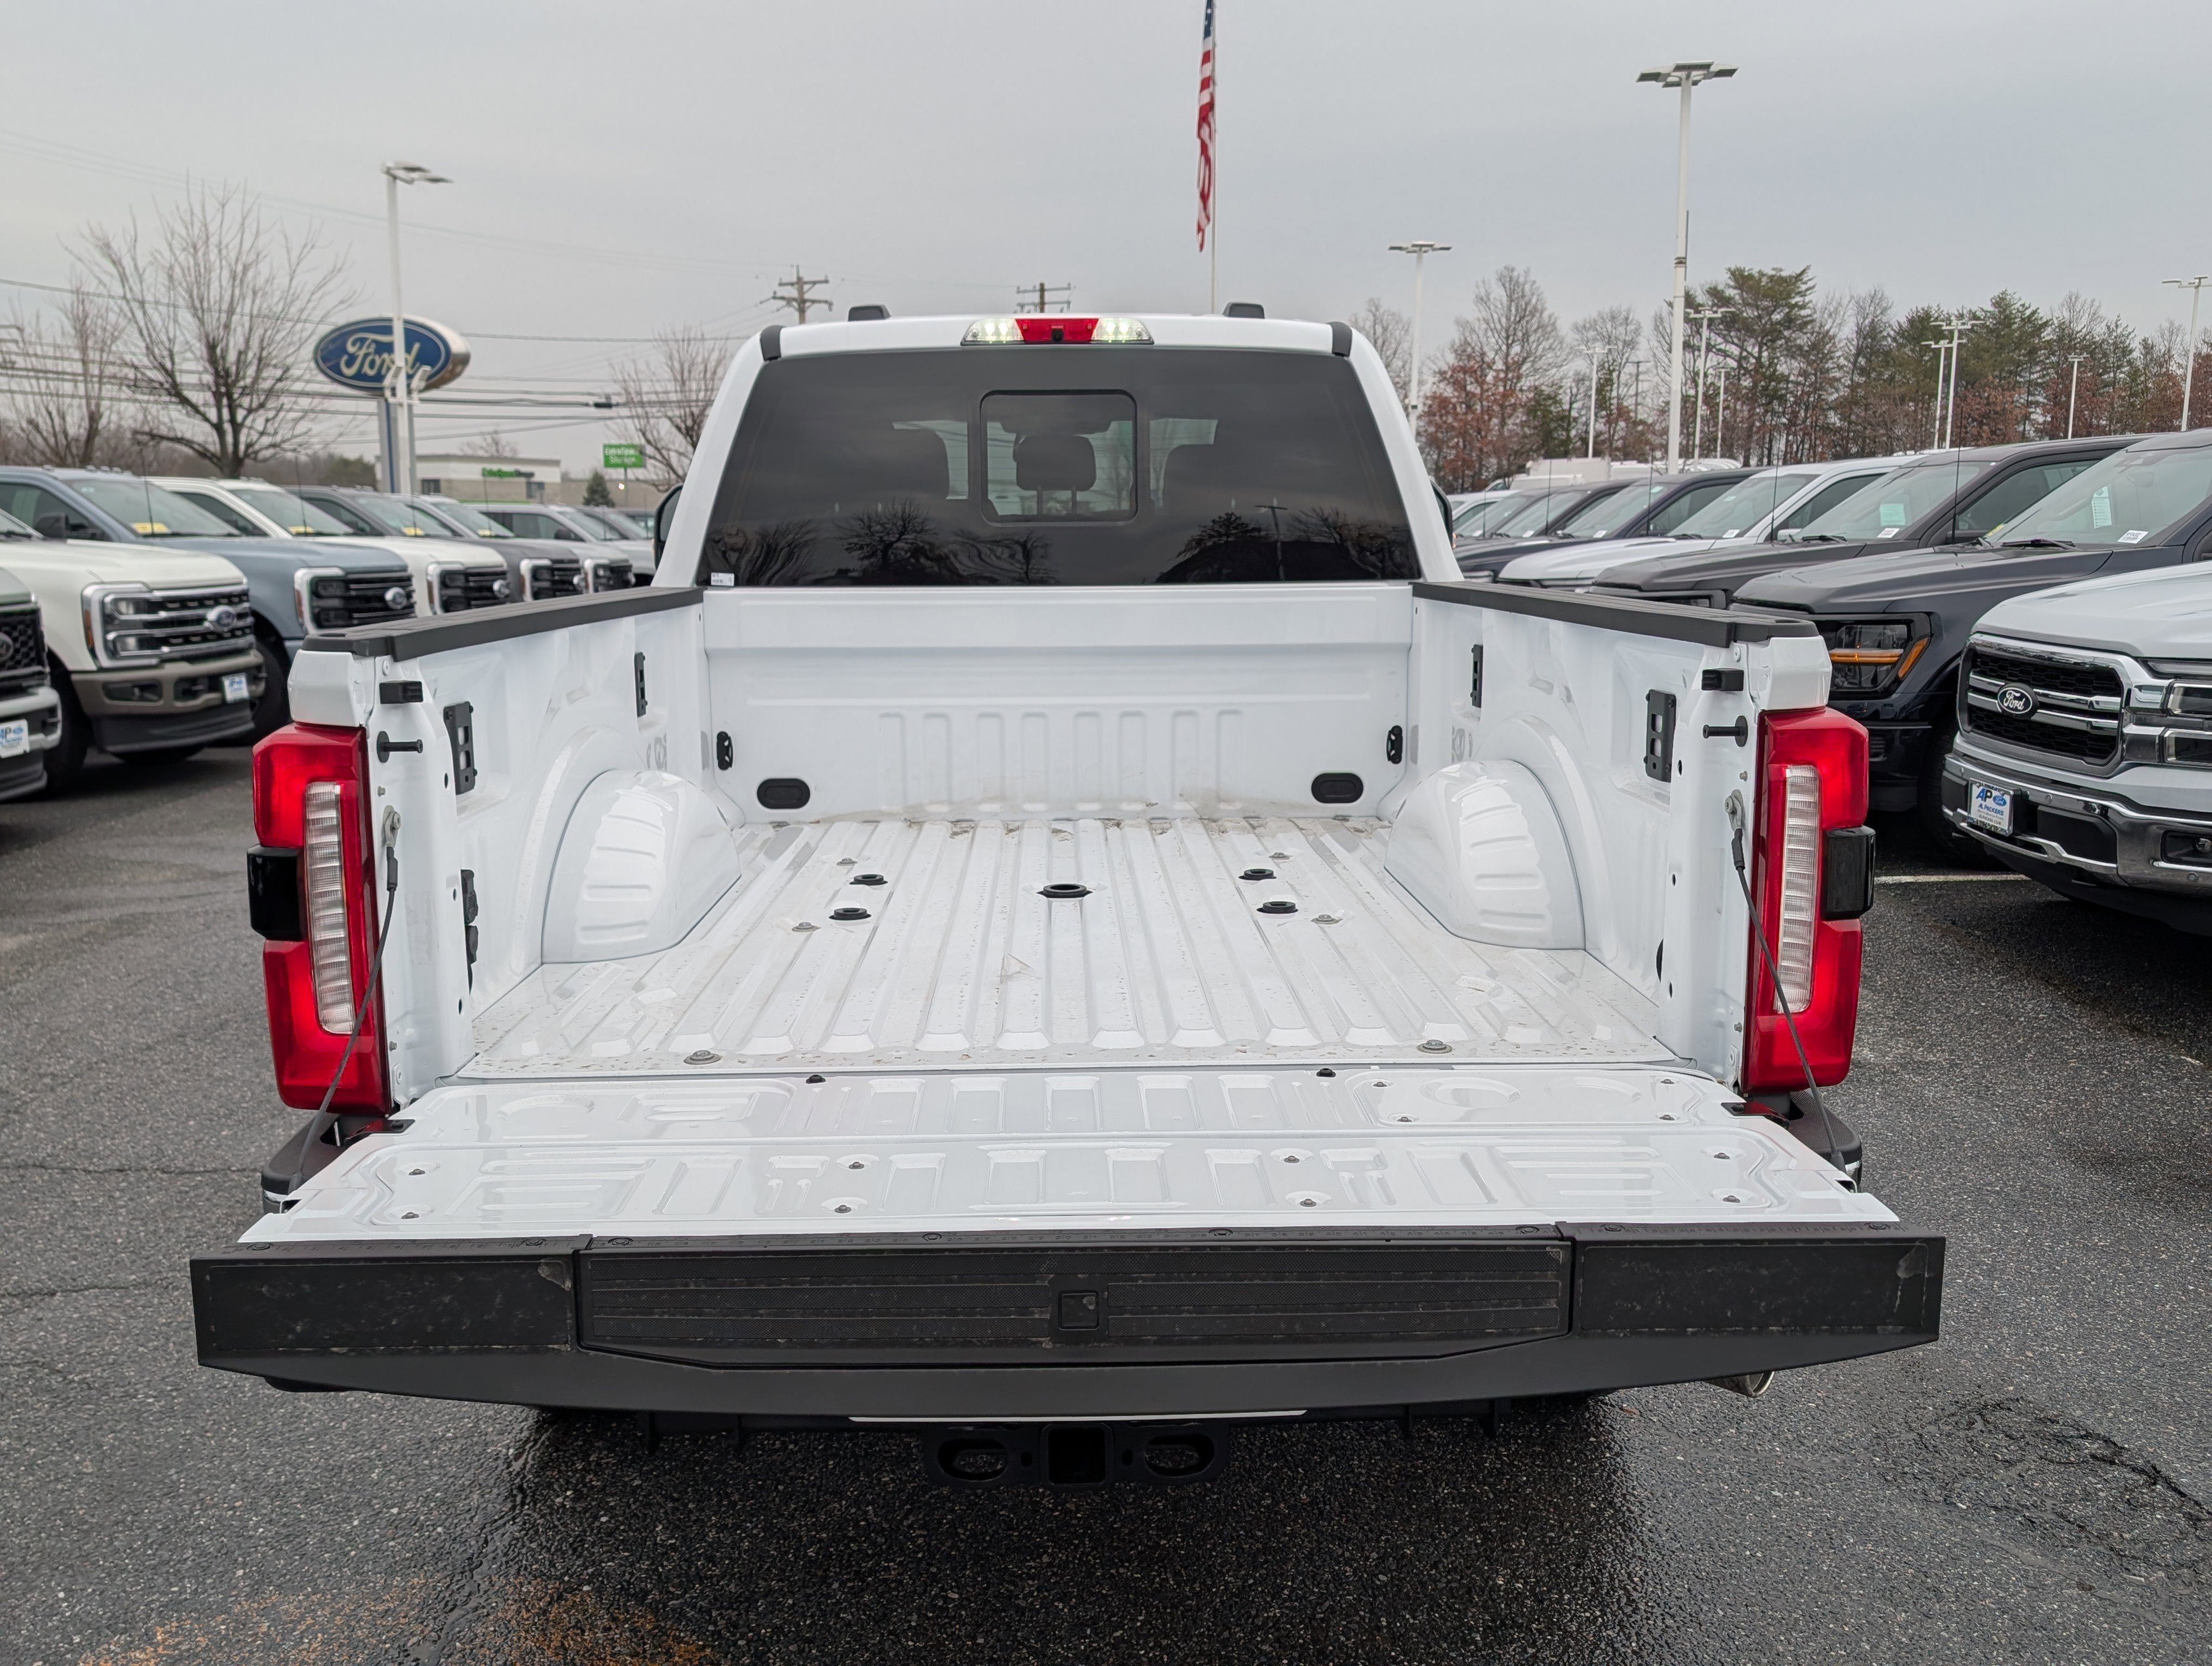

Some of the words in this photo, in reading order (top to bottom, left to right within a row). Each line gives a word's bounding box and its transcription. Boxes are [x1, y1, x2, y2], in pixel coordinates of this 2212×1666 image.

[340, 332, 420, 377] Ford
[2003, 690, 2025, 710] Ford
[1976, 787, 1992, 802] AP
